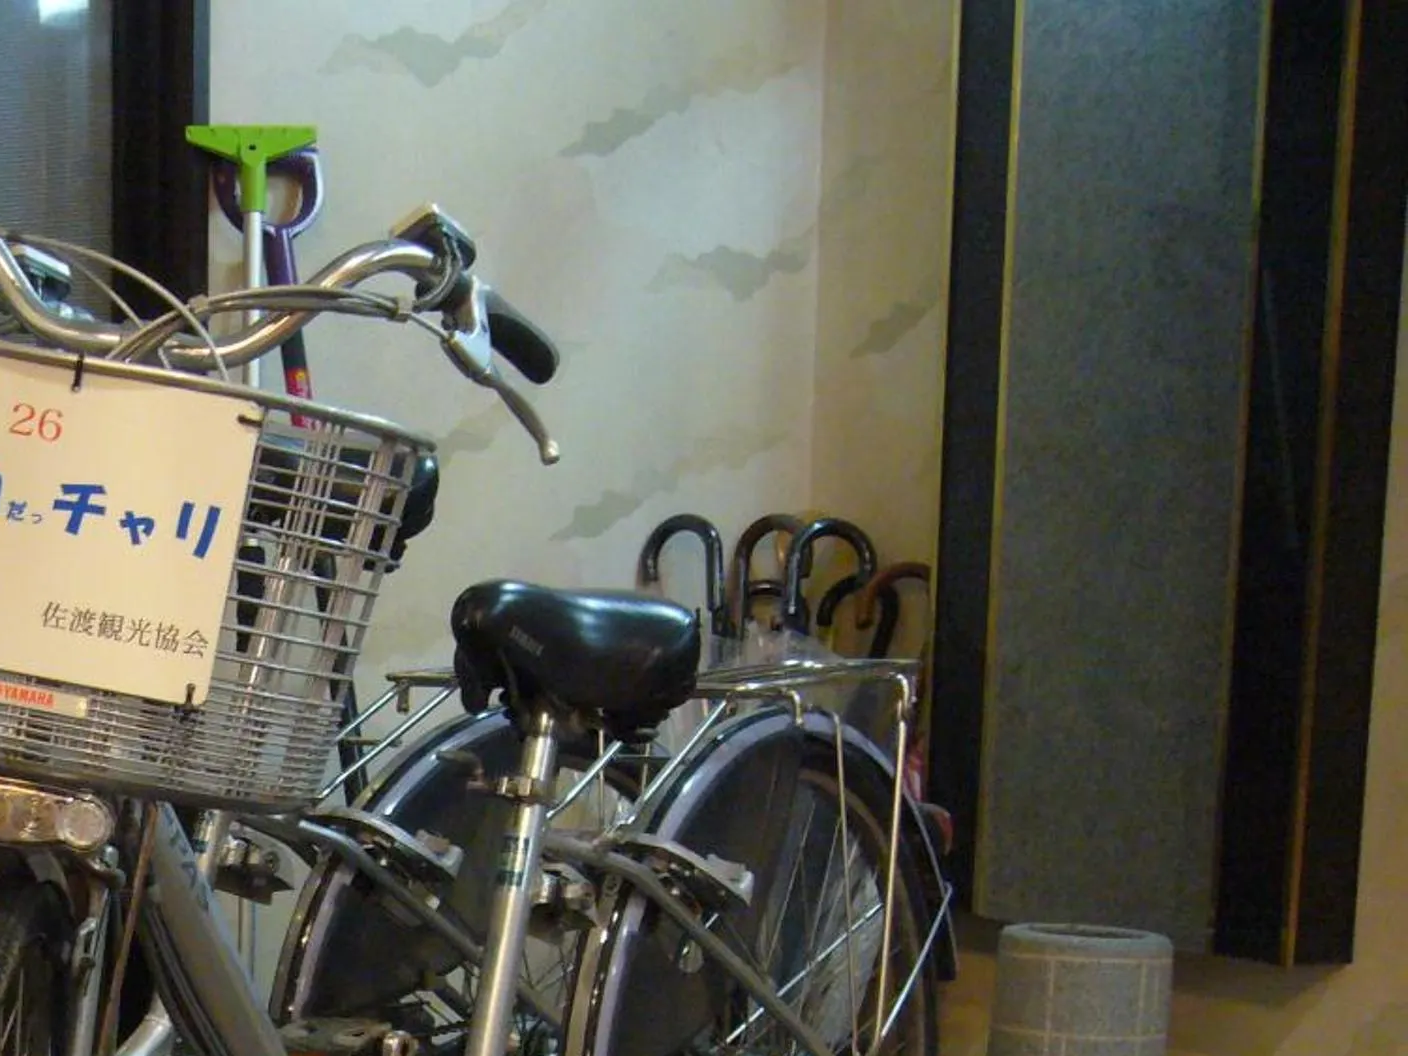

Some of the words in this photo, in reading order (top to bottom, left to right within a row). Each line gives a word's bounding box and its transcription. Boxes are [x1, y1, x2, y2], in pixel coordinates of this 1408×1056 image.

[9, 403, 63, 442] 26
[41, 601, 209, 657] 佐渡観光協会
[3, 685, 54, 706] YAMAHA
